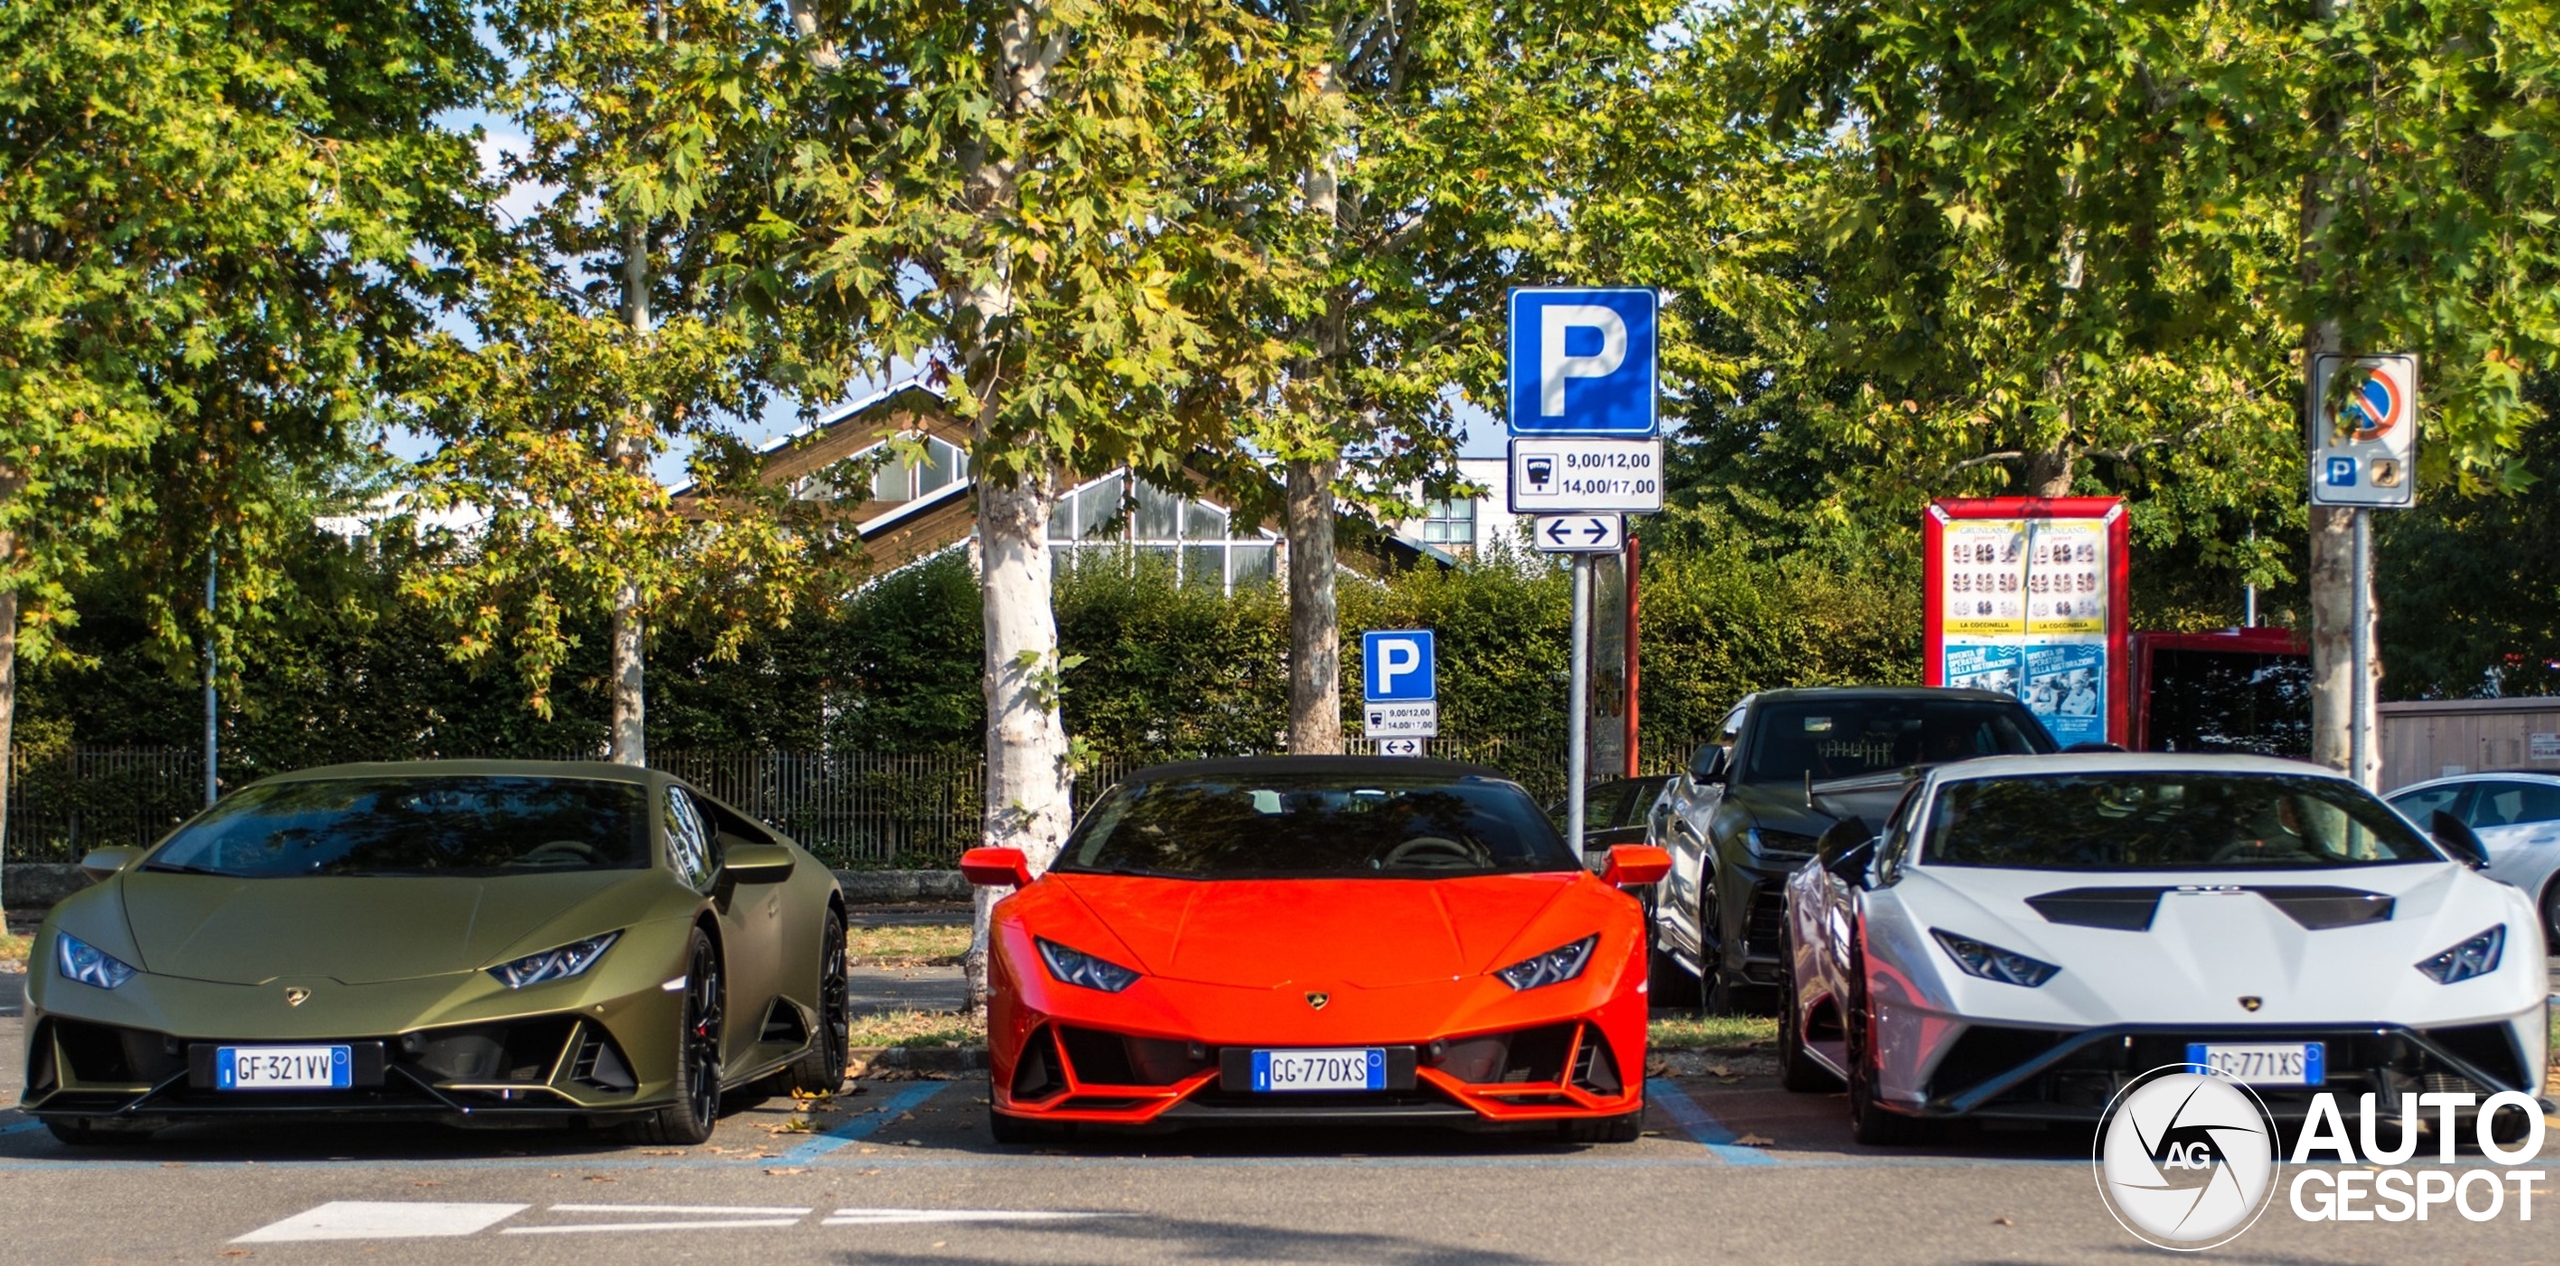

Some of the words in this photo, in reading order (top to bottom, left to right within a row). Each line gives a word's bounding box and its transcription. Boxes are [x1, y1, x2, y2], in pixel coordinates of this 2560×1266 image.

[1541, 305, 1627, 416] P
[1567, 454, 1650, 469] 9,00/12,00
[2332, 461, 2350, 483] P
[1563, 480, 1655, 495] 14,00/17,00
[1378, 638, 1420, 693] P
[1389, 708, 1430, 717] 9,00/12,00
